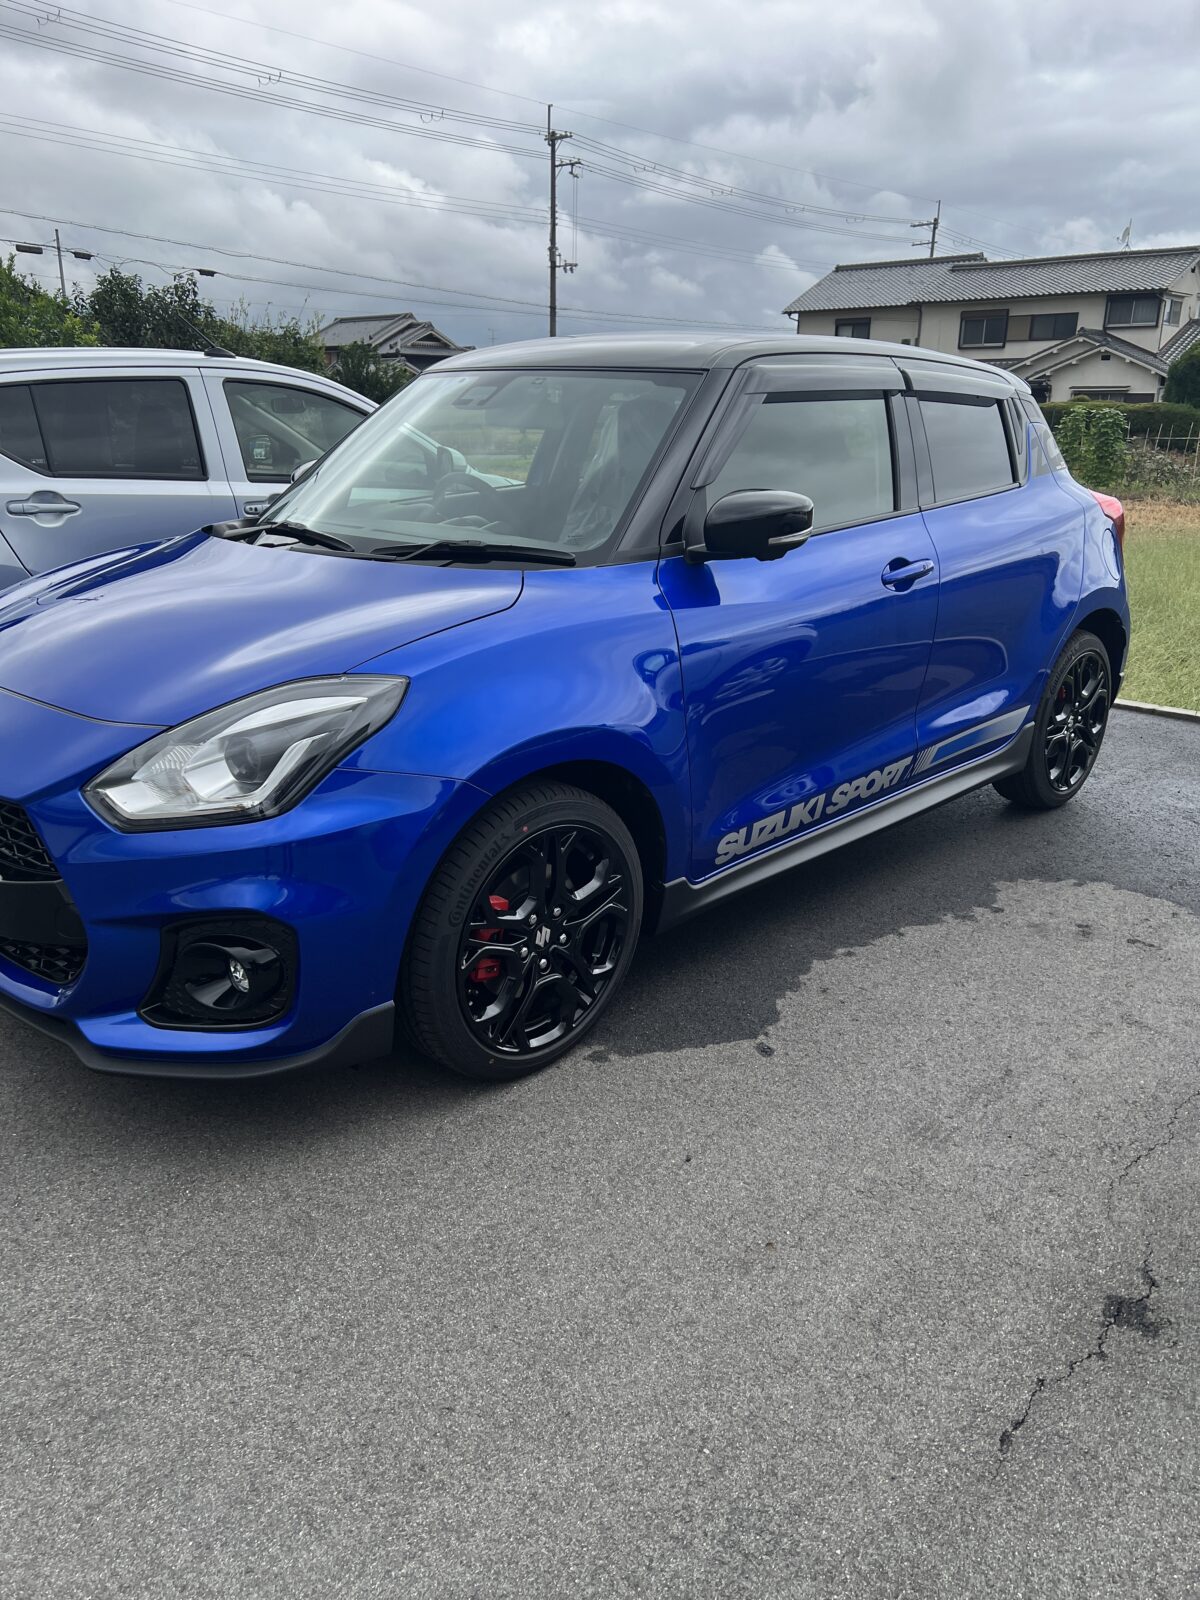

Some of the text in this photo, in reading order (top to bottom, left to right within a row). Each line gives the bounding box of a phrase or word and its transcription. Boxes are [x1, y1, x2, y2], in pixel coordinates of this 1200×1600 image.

[714, 755, 914, 865] SUZUKI SPORT
[449, 840, 505, 927] Continental
